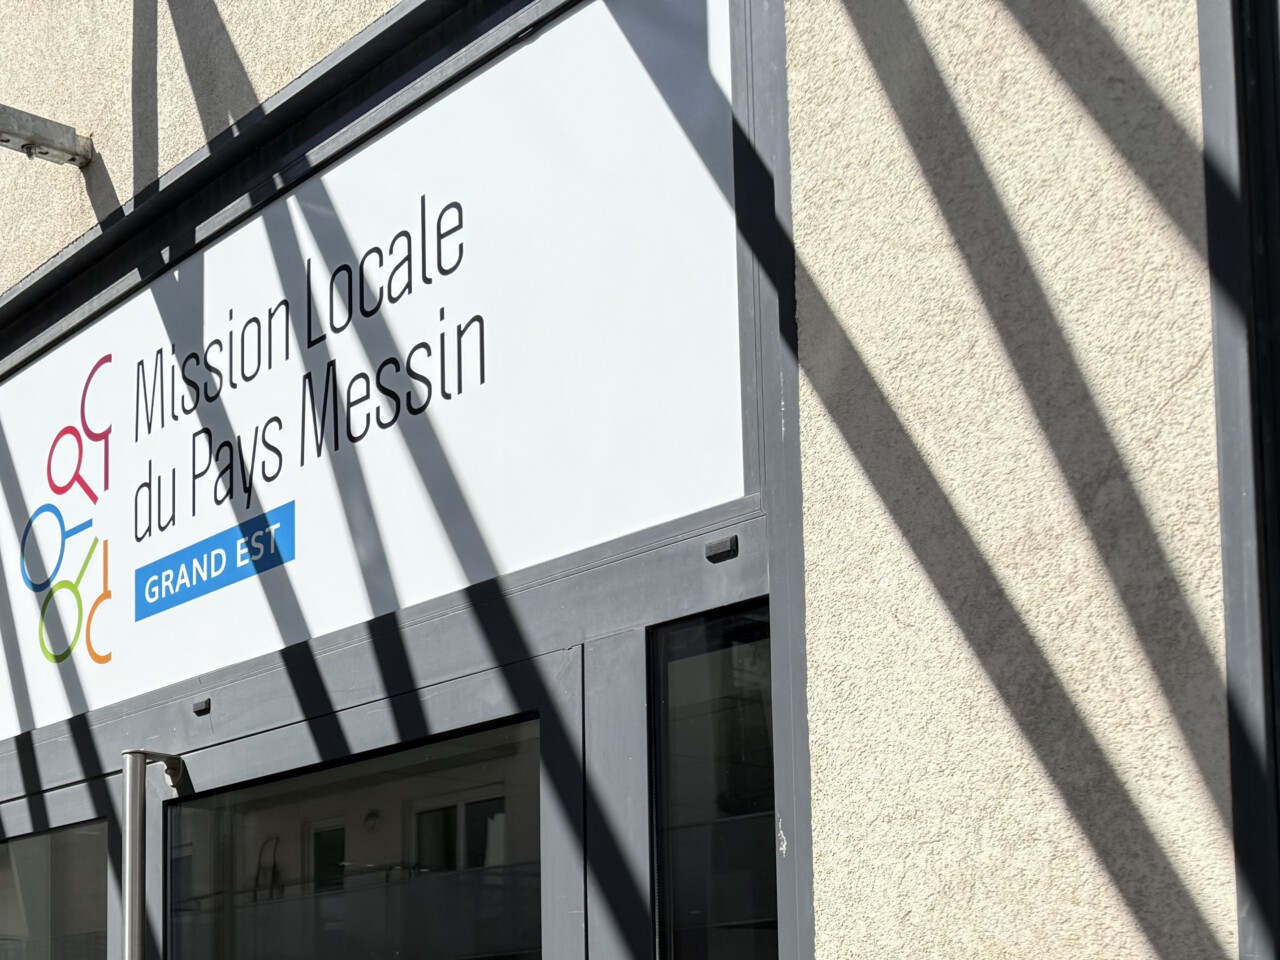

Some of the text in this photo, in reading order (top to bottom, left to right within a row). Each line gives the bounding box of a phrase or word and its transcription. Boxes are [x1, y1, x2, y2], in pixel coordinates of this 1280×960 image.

[134, 194, 465, 443] Mission Locale
[134, 307, 486, 543] du Pays Messin
[143, 522, 281, 604] GRAND EST
